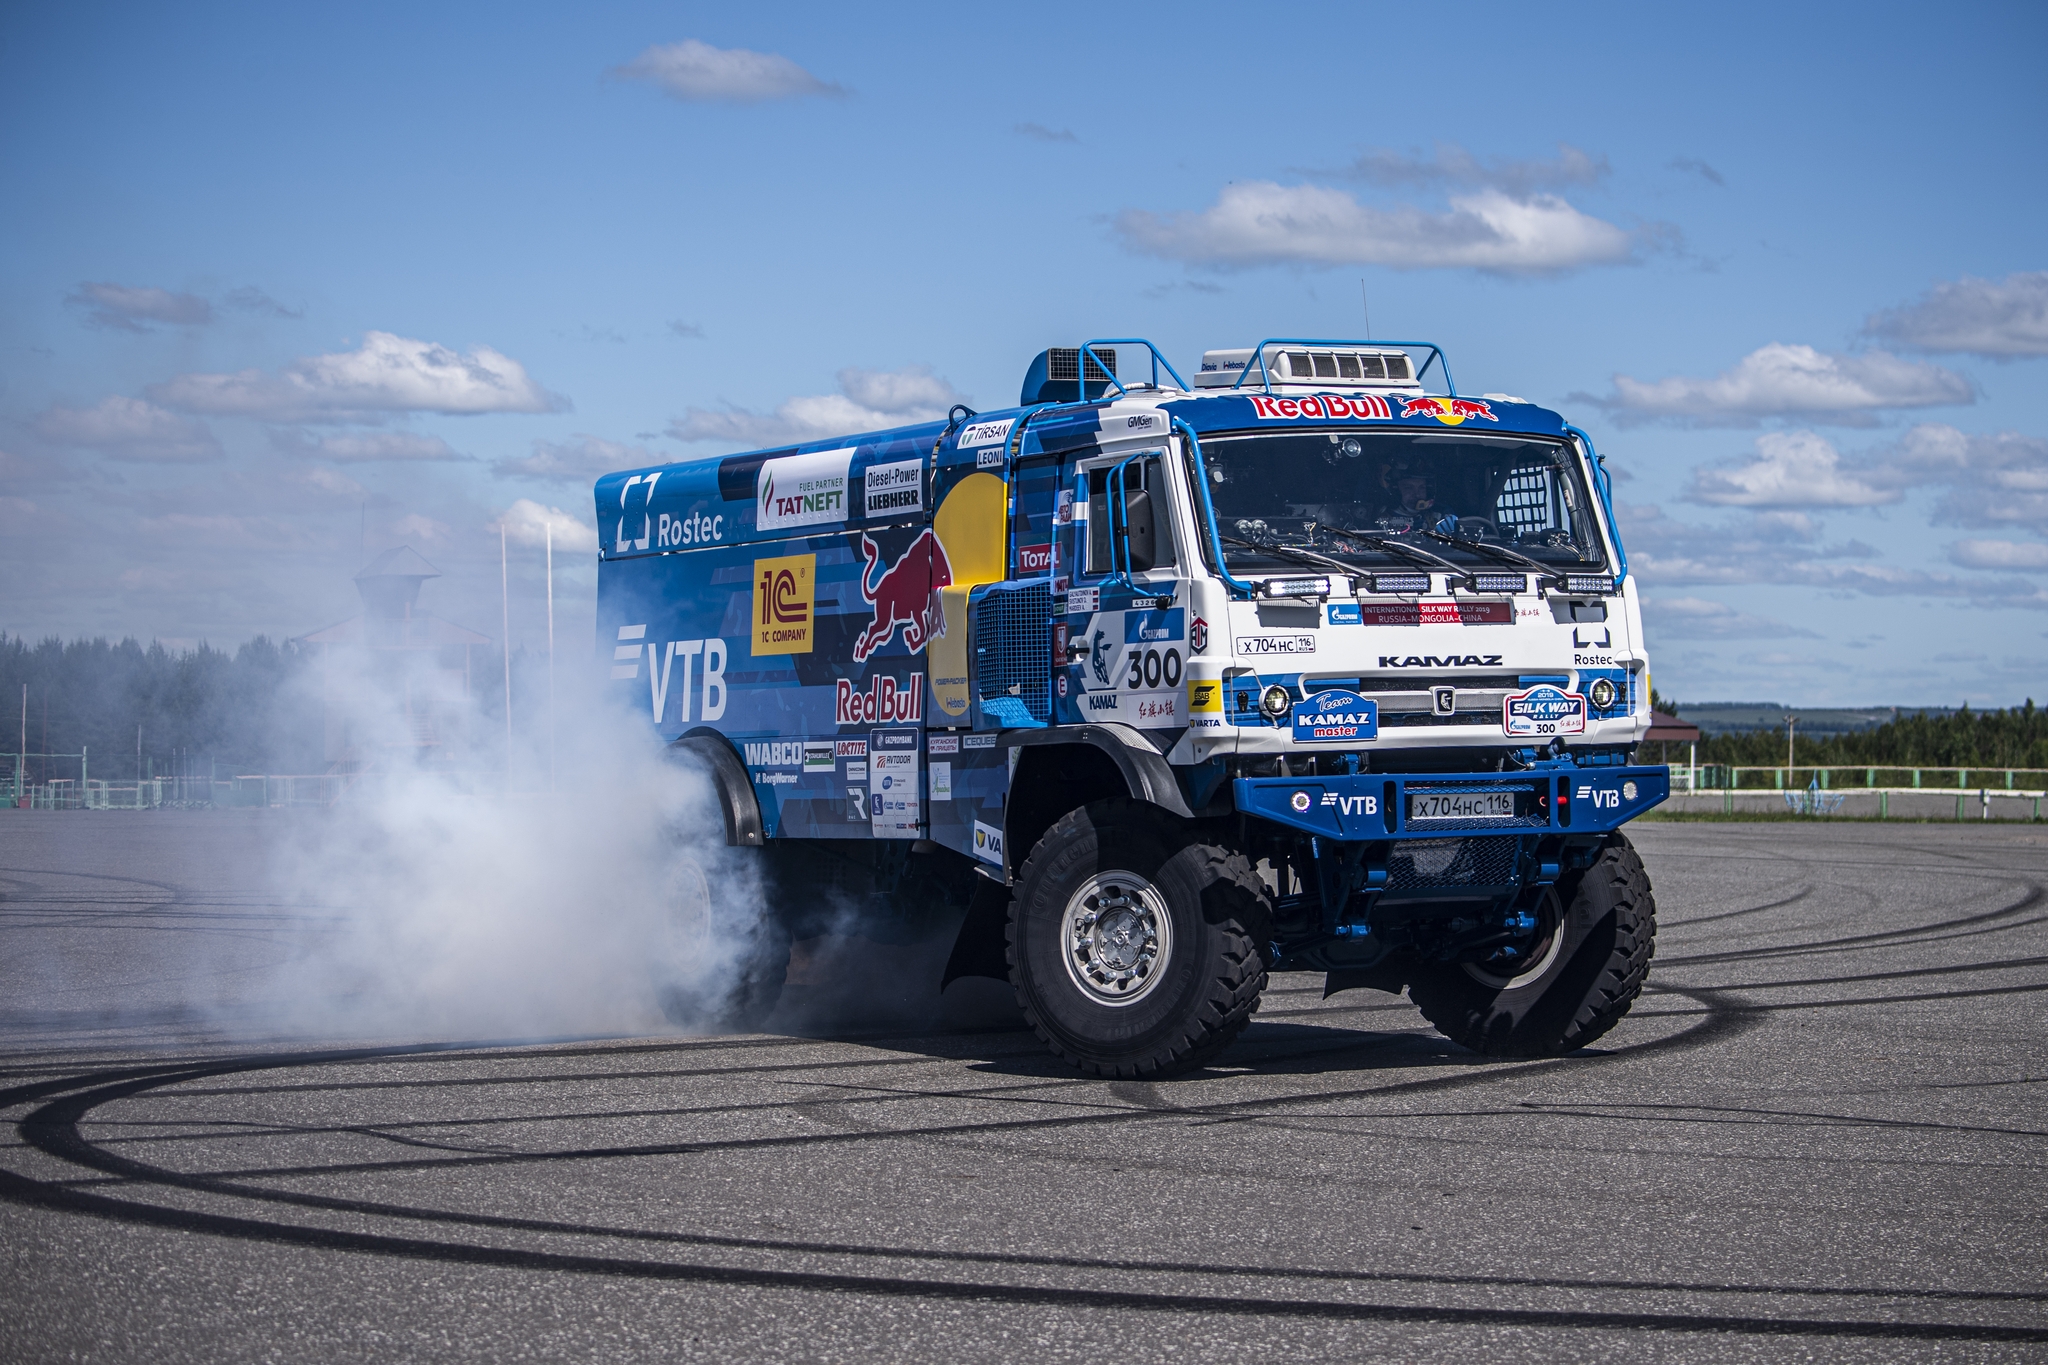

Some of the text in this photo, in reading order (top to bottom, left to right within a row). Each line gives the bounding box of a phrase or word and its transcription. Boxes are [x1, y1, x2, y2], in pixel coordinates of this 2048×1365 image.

[1223, 361, 1246, 370] Webasto
[1248, 394, 1393, 420] Red Bull
[978, 451, 1003, 466] LEONI
[799, 477, 844, 492] FUEL PARTNER
[867, 468, 919, 488] Diesel-Power
[776, 490, 843, 517] TATNEFT
[867, 489, 920, 511] LIEBHERR
[658, 511, 723, 548] Rostec
[1421, 605, 1436, 613] SILK
[1436, 605, 1453, 613] WAY
[1453, 605, 1474, 613] RALLY
[1475, 606, 1491, 614] 2019
[761, 628, 807, 644] 1C COMPANY
[1147, 628, 1170, 639] GAZPROM
[1298, 637, 1312, 646] 116
[1378, 655, 1503, 668] KAMAZ
[1574, 654, 1613, 665] Rostec
[1128, 648, 1182, 690] 300
[647, 637, 728, 724] VTB
[835, 672, 924, 725] Red Bull
[1089, 694, 1118, 711] KAMAZ
[1194, 692, 1210, 700] ESAB
[1316, 693, 1354, 712] Team
[1512, 701, 1579, 714] SILK WAY
[1195, 719, 1221, 727] VARTA
[1298, 713, 1370, 726] KAMAZ
[1314, 726, 1358, 737] master
[1536, 723, 1556, 734] 300
[884, 735, 913, 745] GAZPROMBANK
[965, 736, 997, 747] ICEQUEE
[744, 742, 803, 766] WABCO
[836, 741, 867, 756] LOCTITE
[886, 754, 912, 765] AVTODOR
[762, 772, 798, 786] BorgWarner
[1339, 795, 1378, 816] VTB
[1486, 794, 1510, 809] 116
[1592, 789, 1620, 808] VTB
